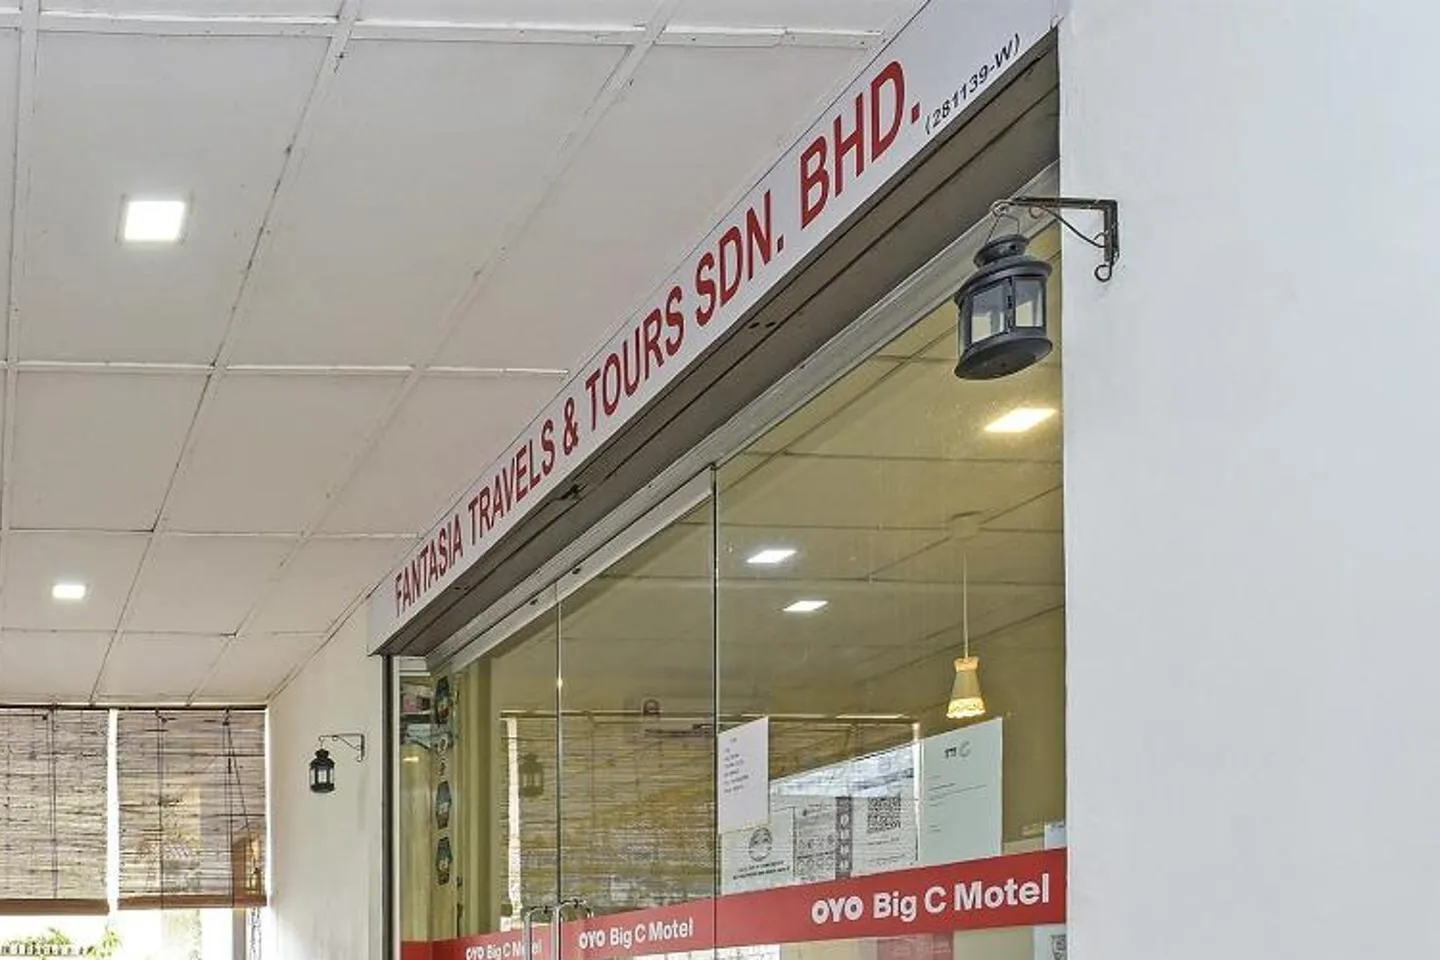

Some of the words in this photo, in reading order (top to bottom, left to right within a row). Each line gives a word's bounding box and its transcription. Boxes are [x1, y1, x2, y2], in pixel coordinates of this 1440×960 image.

[925, 33, 1020, 135] (281139-W)
[394, 514, 464, 618] FANTASIA
[467, 418, 557, 548] TRAVELS
[562, 396, 580, 456] &
[585, 285, 686, 430] TOURS
[695, 190, 784, 326] SDN.
[800, 60, 921, 226] BHD.
[811, 896, 864, 925] OYO
[873, 891, 917, 922] Big
[924, 886, 947, 914] C
[954, 872, 1050, 912] Motel
[466, 946, 484, 960] OYO
[503, 942, 511, 957] C
[579, 932, 606, 950] OYO
[610, 929, 632, 949] Big
[635, 923, 646, 943] C
[648, 917, 694, 942] Motel
